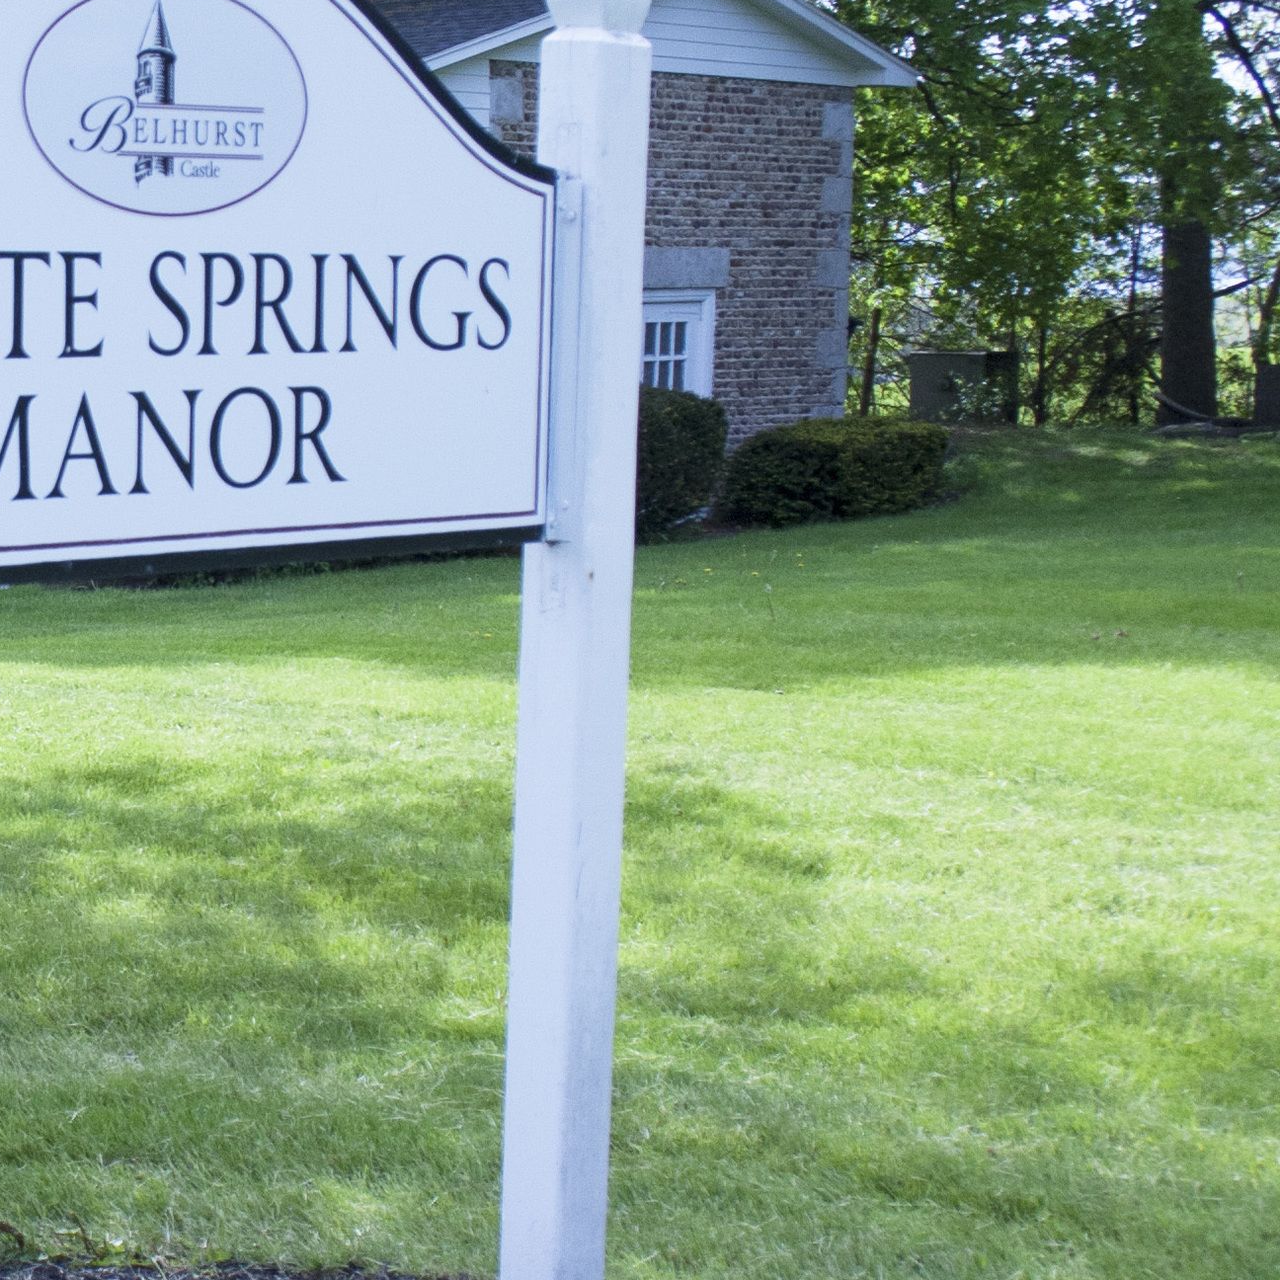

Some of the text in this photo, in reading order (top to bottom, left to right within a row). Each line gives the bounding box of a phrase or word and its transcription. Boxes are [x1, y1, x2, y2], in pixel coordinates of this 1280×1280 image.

[69, 96, 264, 153] BELHURST
[180, 160, 221, 178] Castle
[147, 251, 512, 357] SPRINGS
